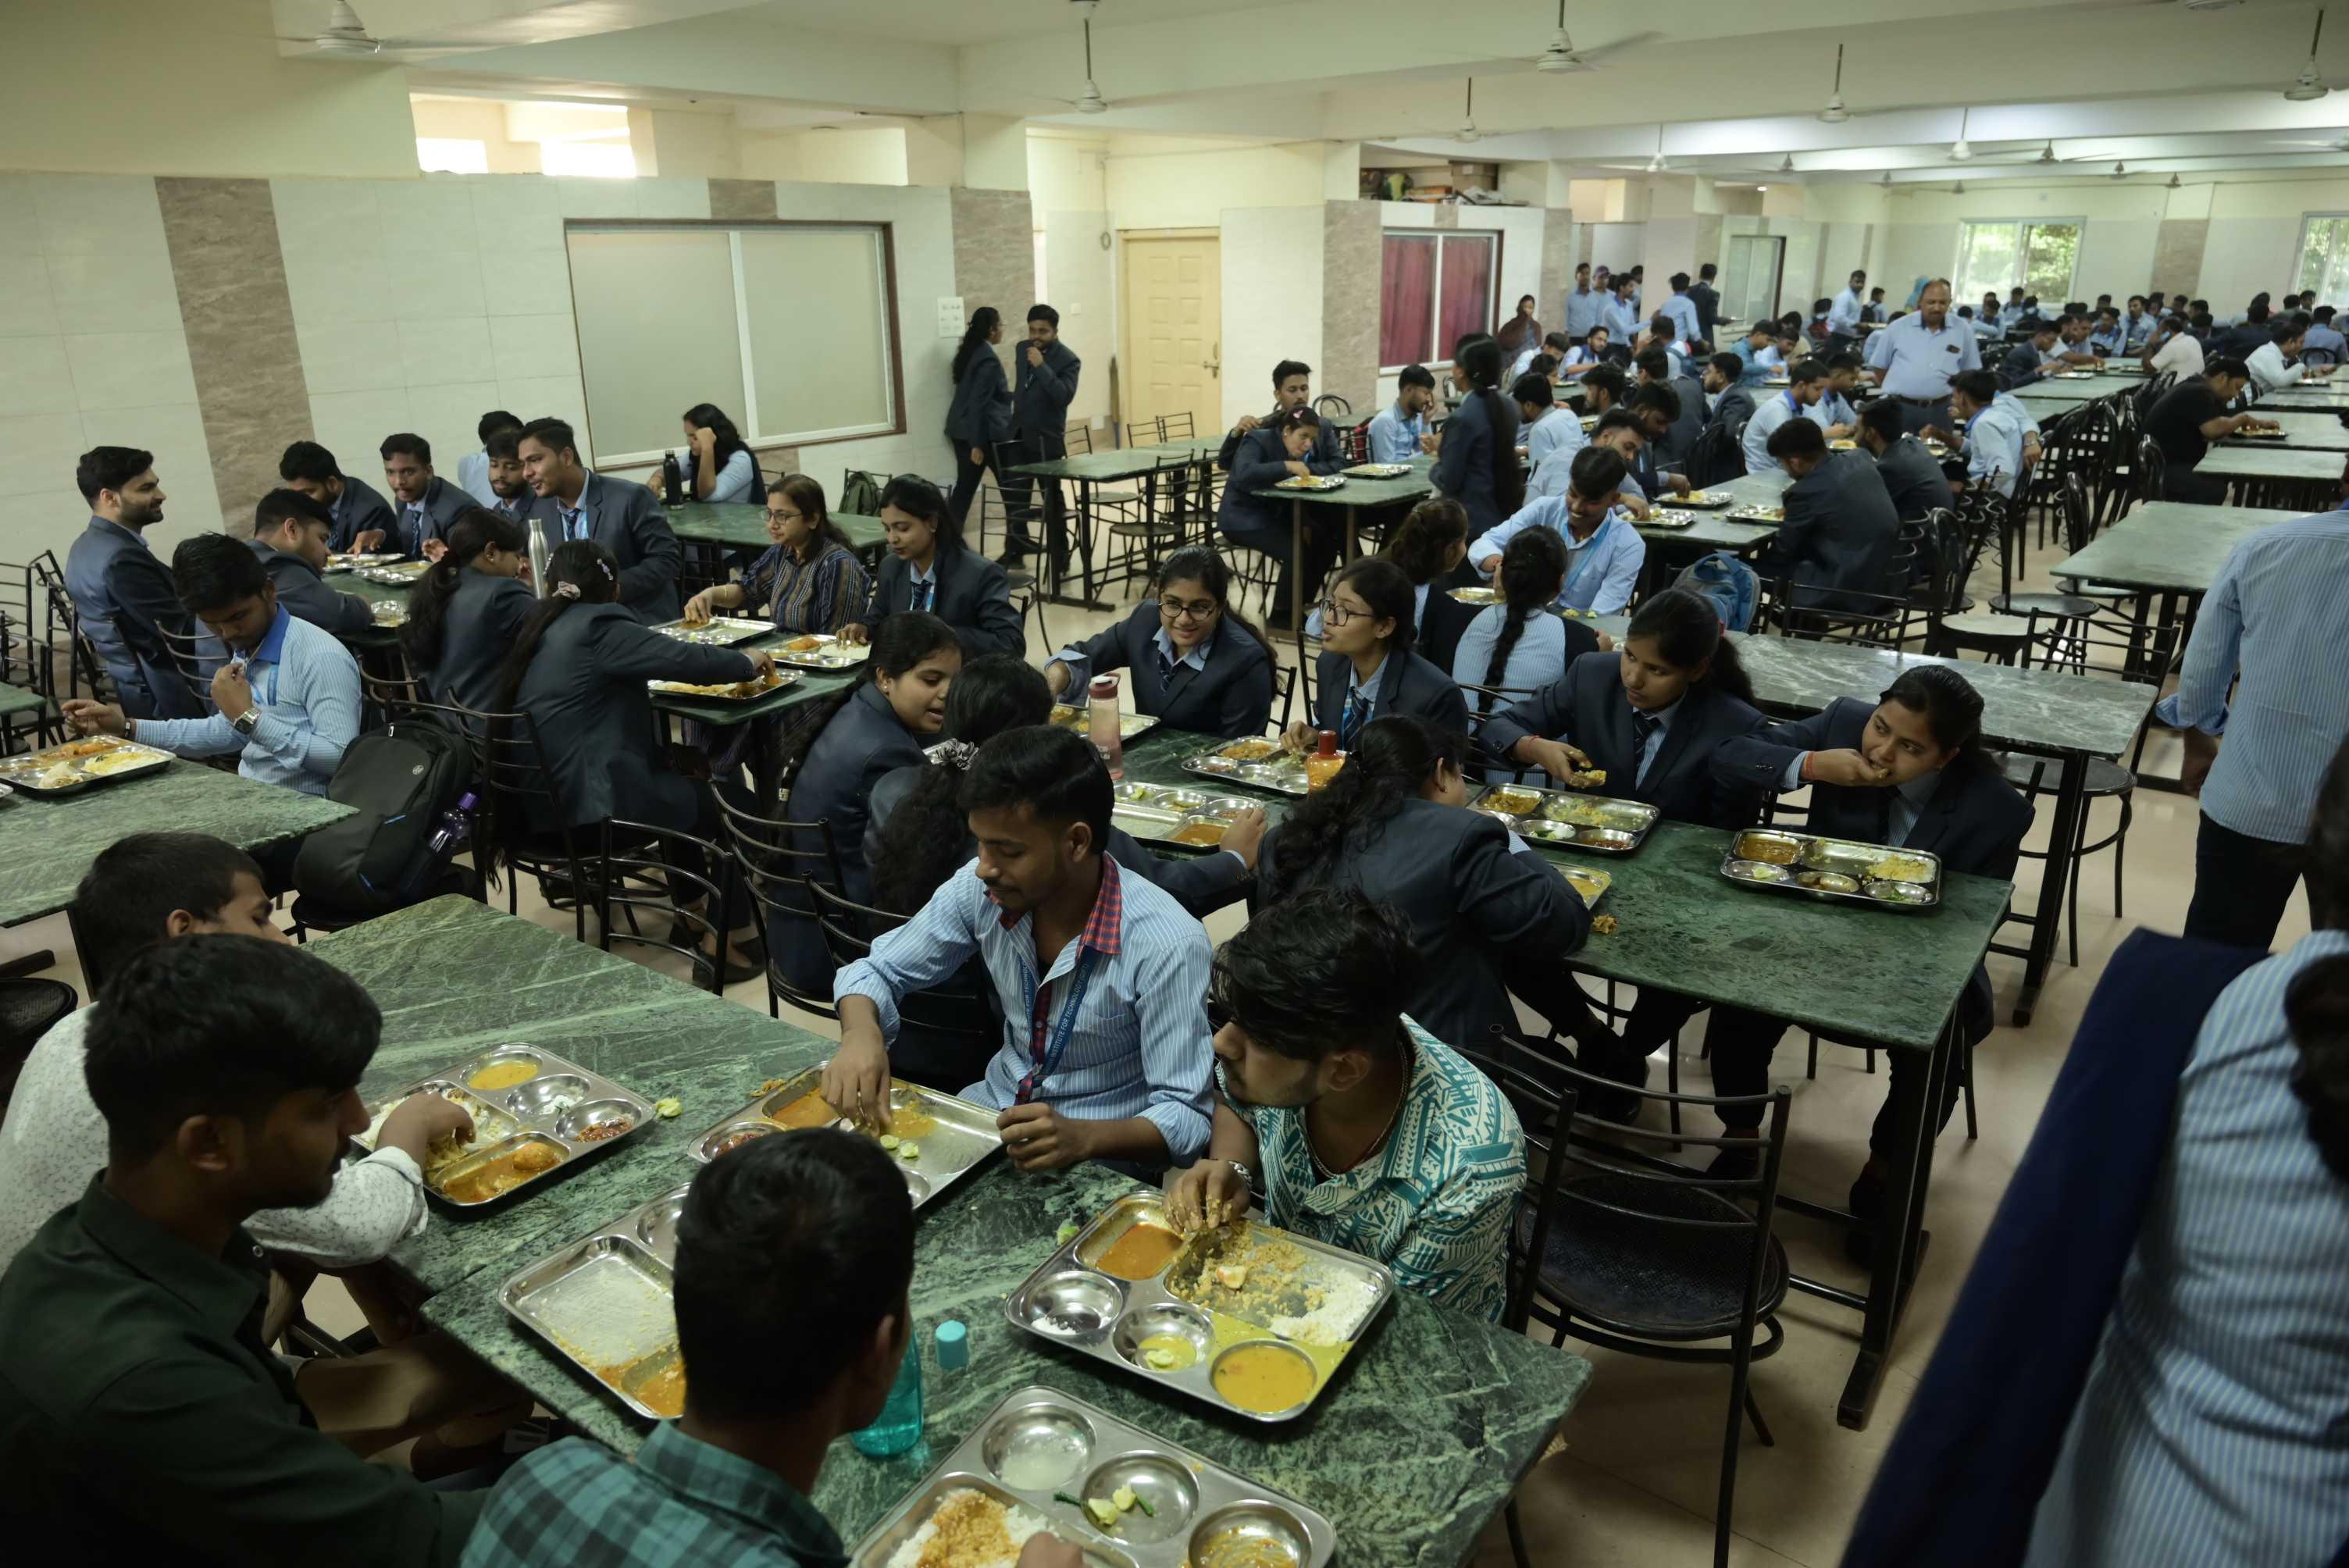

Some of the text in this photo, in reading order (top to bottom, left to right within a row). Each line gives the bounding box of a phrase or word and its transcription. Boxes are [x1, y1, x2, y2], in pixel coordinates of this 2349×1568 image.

[1050, 1031, 1064, 1057] INSTITUTE
[1060, 1017, 1069, 1031] FOR
[1065, 979, 1082, 1017] TECHNOLOGY
